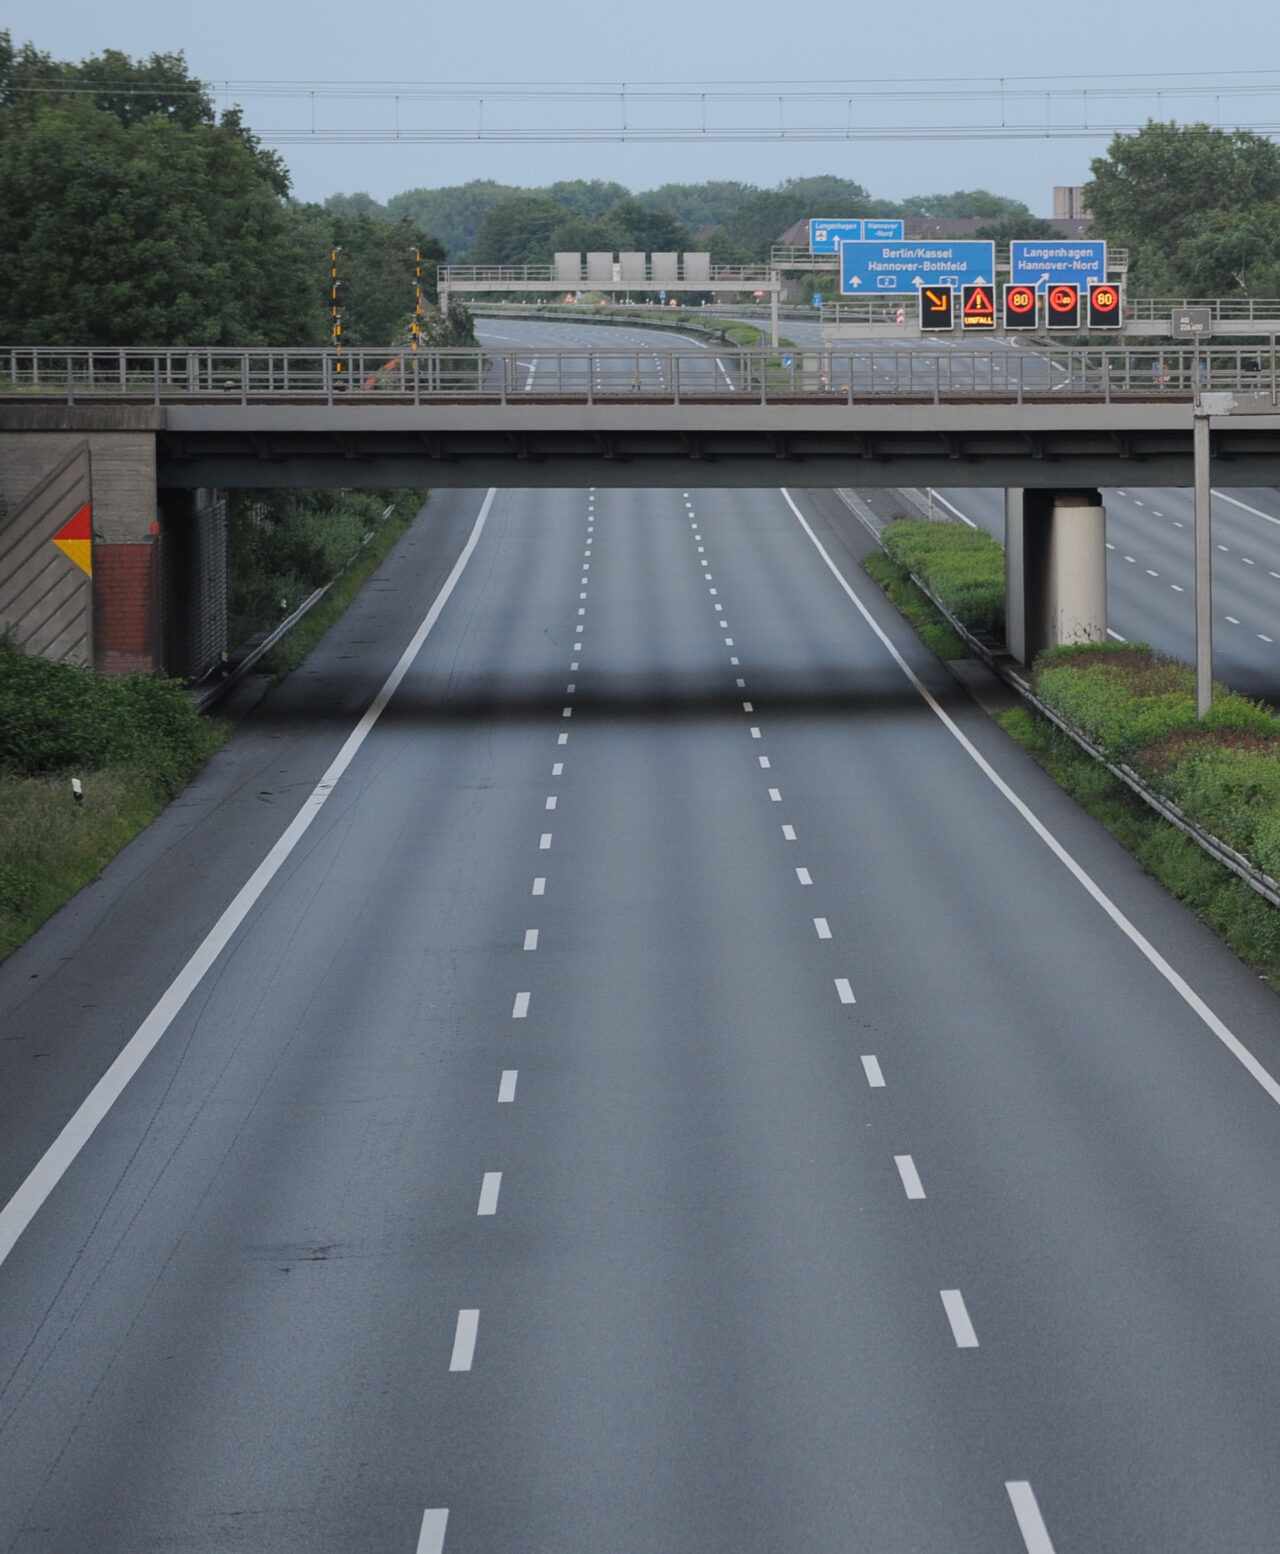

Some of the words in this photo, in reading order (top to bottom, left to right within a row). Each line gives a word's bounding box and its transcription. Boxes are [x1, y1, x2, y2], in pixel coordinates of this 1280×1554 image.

[815, 222, 858, 231] Langenhagen
[882, 247, 953, 259] Berlin/Kassel
[1023, 247, 1094, 260] Langenhagen
[868, 260, 968, 272] Hannover-Bothfeld
[1018, 259, 1099, 271] Hannover-Nord
[883, 278, 890, 286] 2
[1013, 293, 1029, 306] 80
[1097, 292, 1113, 305] 80
[964, 316, 994, 325] UNFALL
